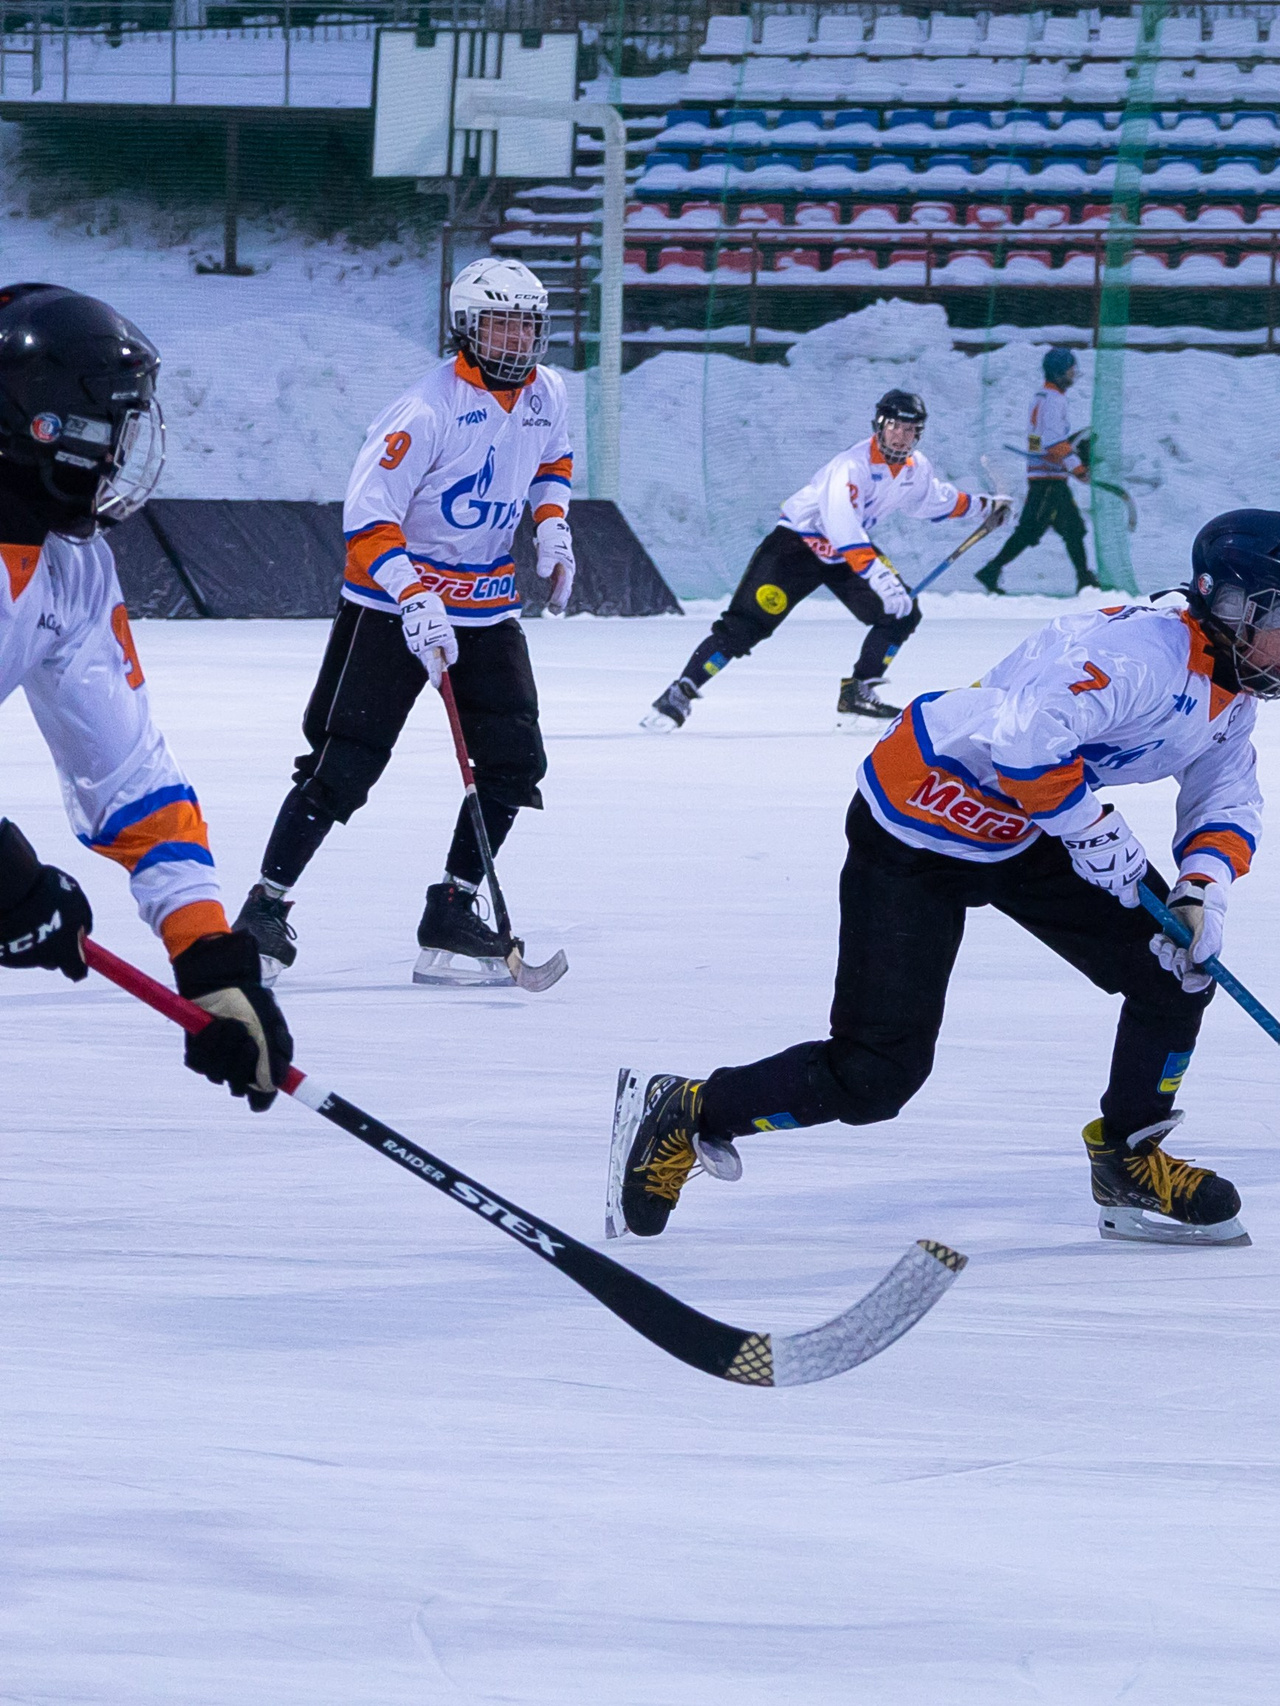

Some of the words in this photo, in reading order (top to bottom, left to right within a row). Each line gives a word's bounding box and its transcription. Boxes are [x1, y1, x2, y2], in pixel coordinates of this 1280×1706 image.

[514, 293, 540, 301] CCM
[379, 430, 412, 470] 9
[1068, 661, 1111, 696] 7
[1065, 827, 1120, 850] STEX
[382, 1139, 446, 1182] RAIDER
[450, 1181, 566, 1257] STEX
